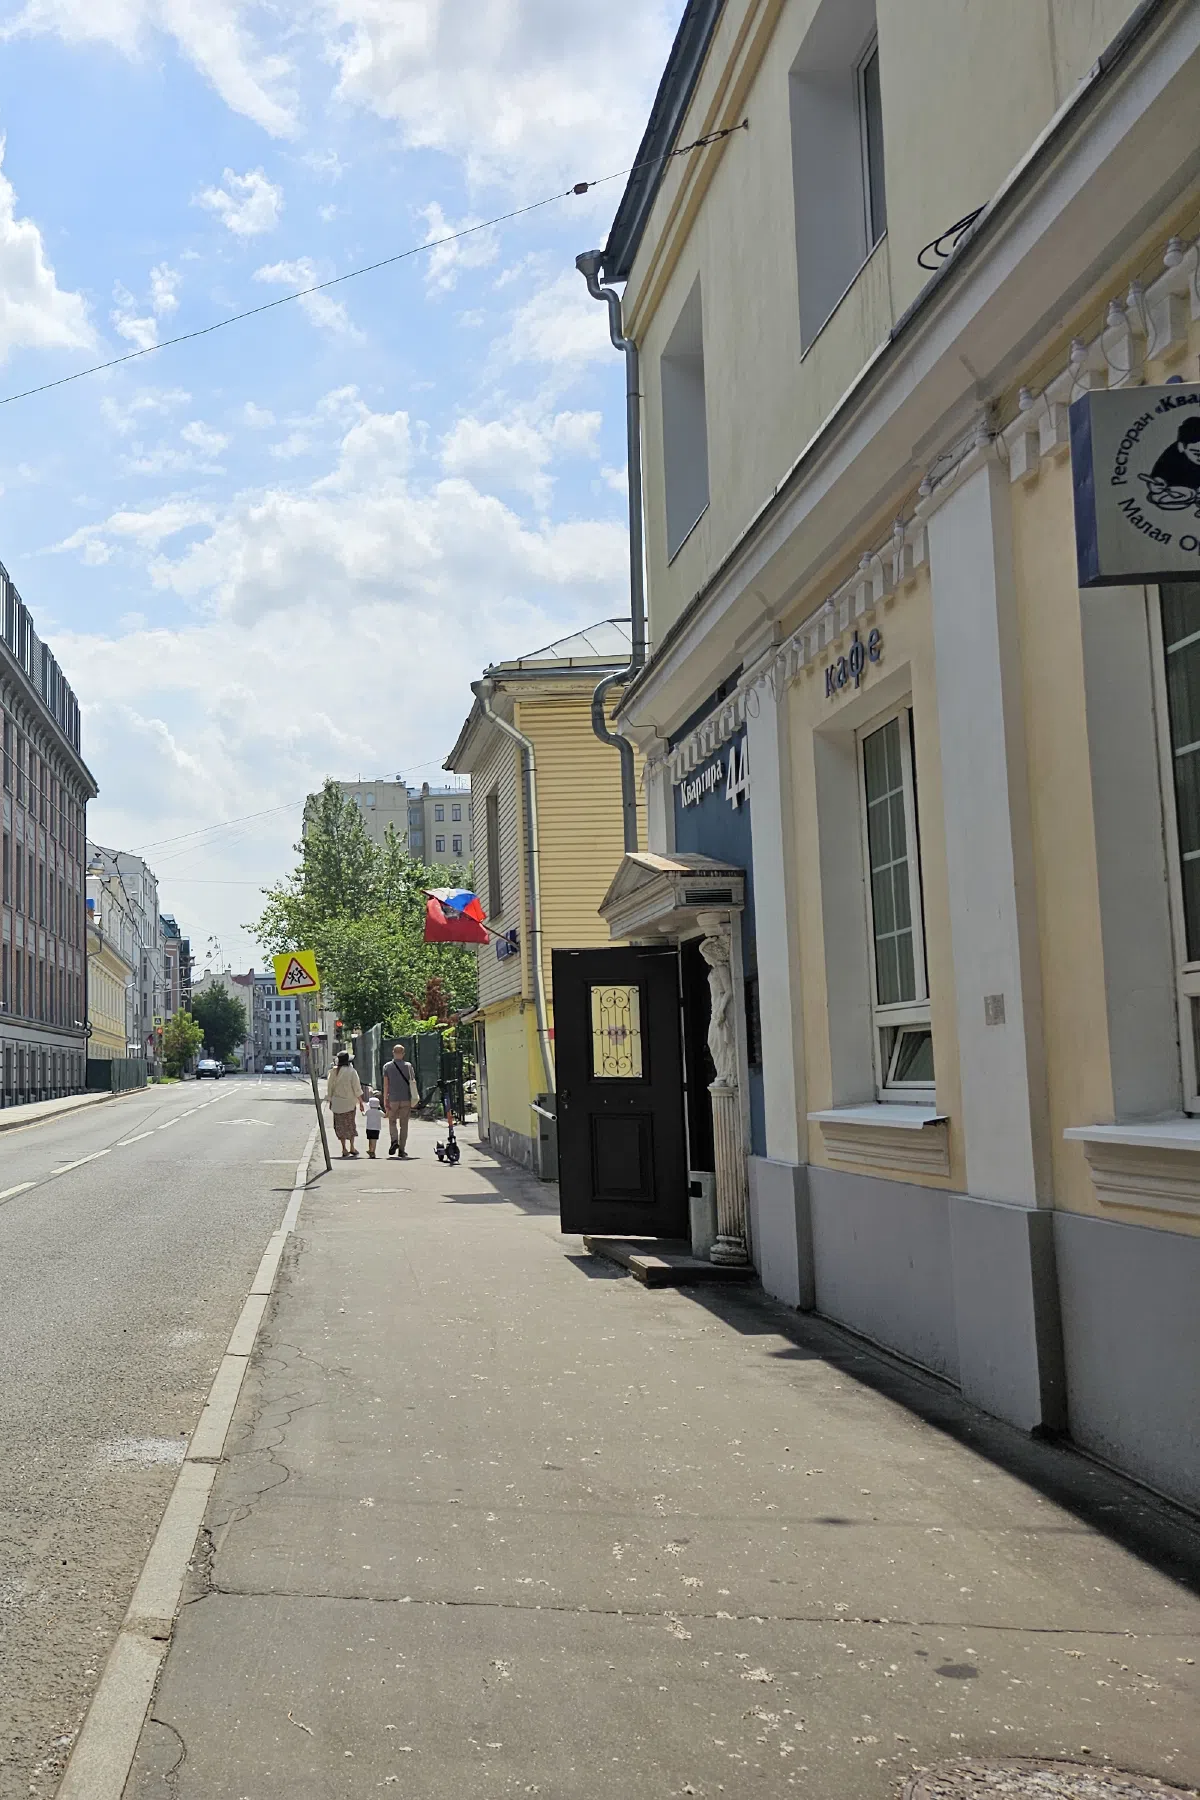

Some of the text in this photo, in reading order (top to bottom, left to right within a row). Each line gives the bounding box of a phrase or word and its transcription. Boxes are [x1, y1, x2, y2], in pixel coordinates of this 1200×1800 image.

[1111, 393, 1200, 486] Ресторан «Ква
[1117, 497, 1200, 556] Малая О
[824, 628, 881, 698] кафе
[681, 734, 751, 810] Квартира 44
